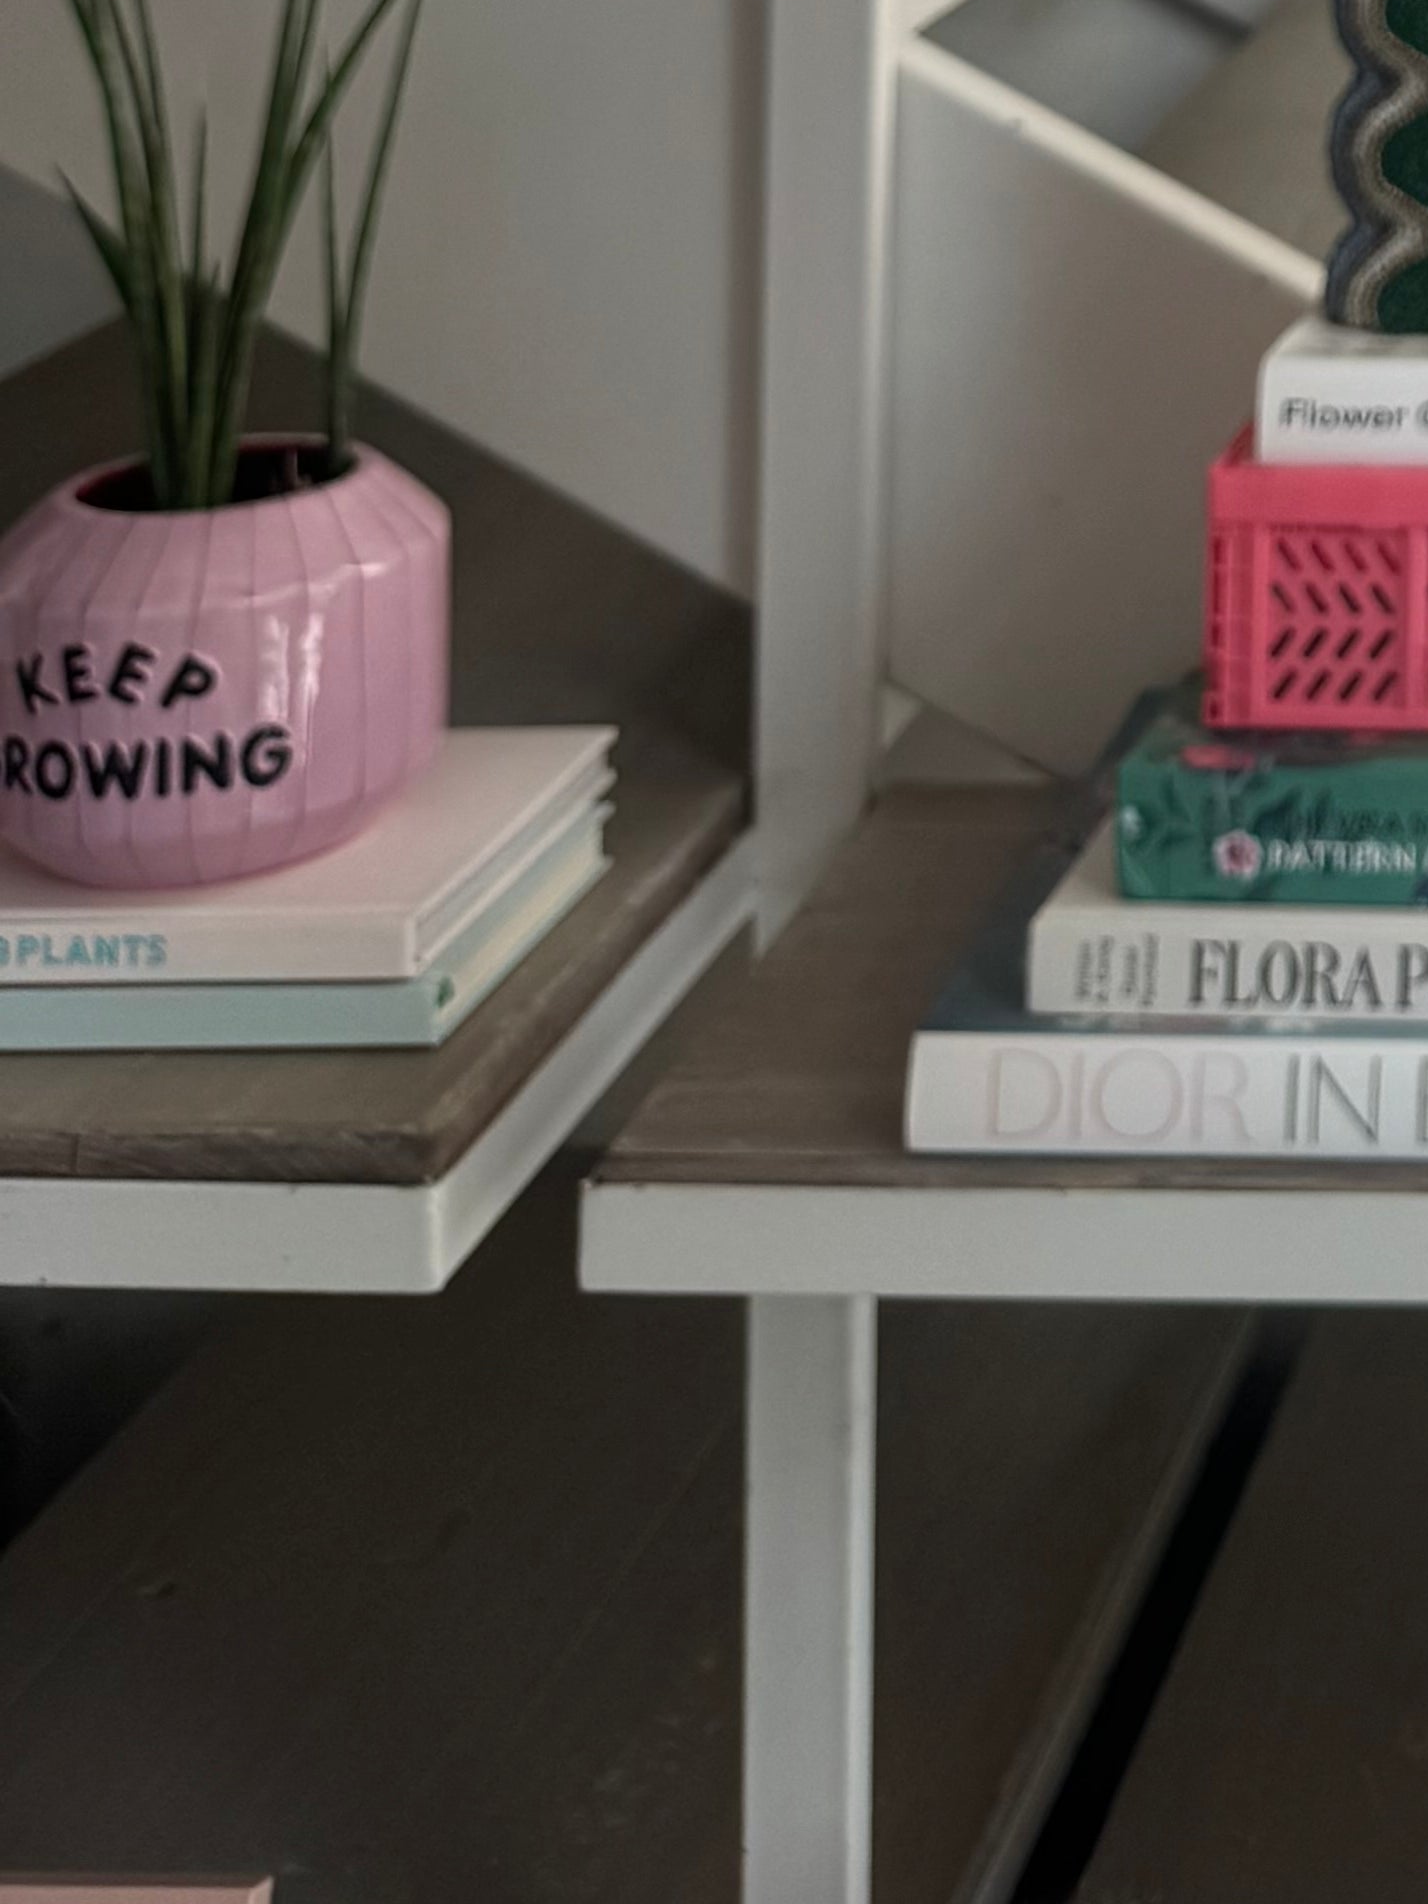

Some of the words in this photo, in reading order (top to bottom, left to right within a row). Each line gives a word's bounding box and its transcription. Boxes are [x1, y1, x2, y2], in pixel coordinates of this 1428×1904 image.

[1279, 395, 1409, 431] Flower
[16, 641, 217, 714] KEEP
[0, 722, 293, 801] ROWING
[1266, 837, 1418, 876] PATTERN
[1186, 937, 1383, 1012] FLORA
[984, 1046, 1256, 1144] DIOR
[1283, 1051, 1383, 1146] IN
